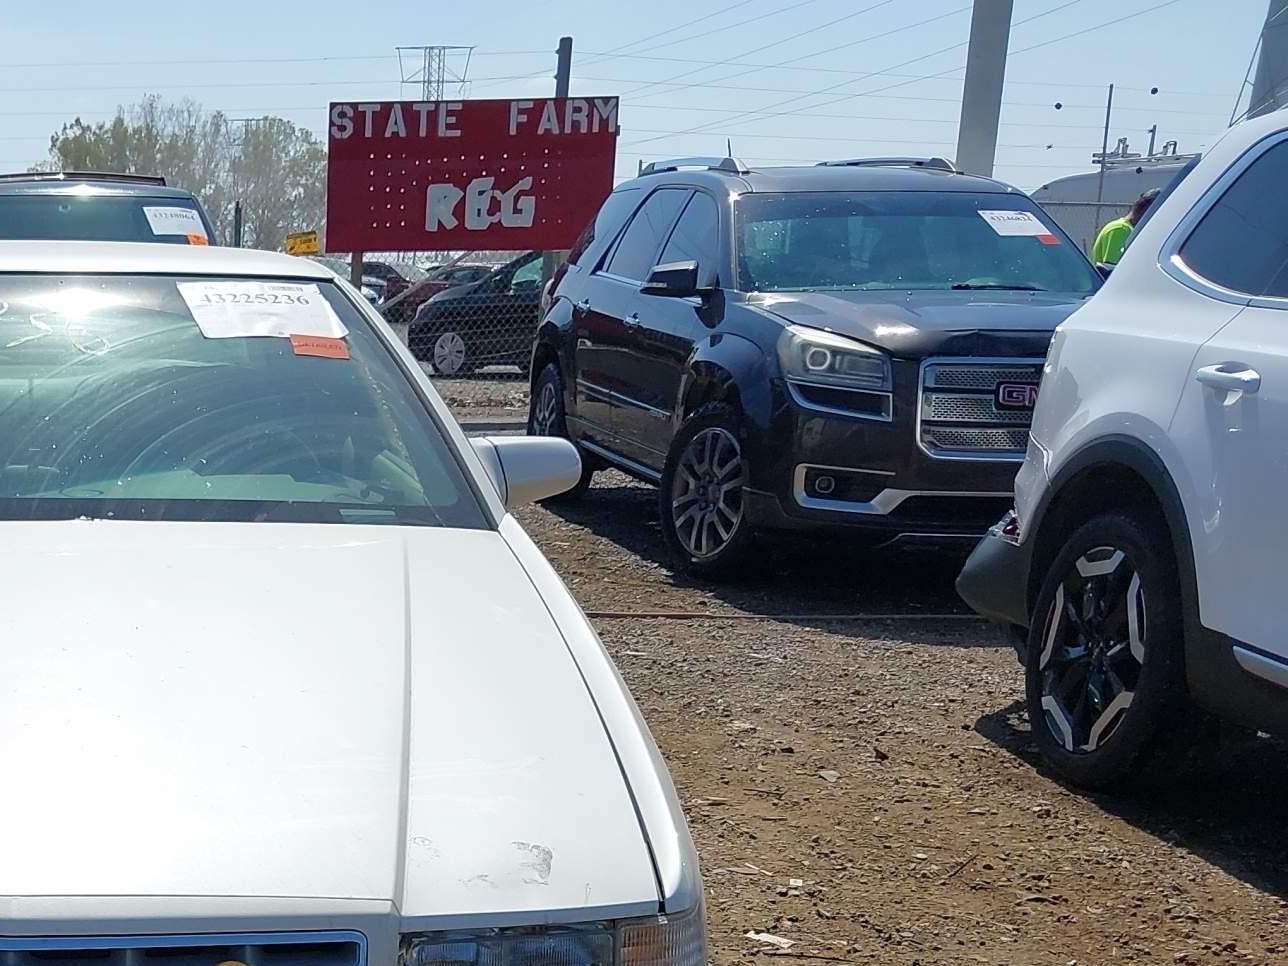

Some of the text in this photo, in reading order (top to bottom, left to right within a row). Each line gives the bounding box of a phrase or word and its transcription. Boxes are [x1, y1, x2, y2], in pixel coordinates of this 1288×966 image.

[330, 99, 618, 139] STATE FARM
[201, 292, 311, 306] 43225236
[999, 384, 1038, 407] GM
